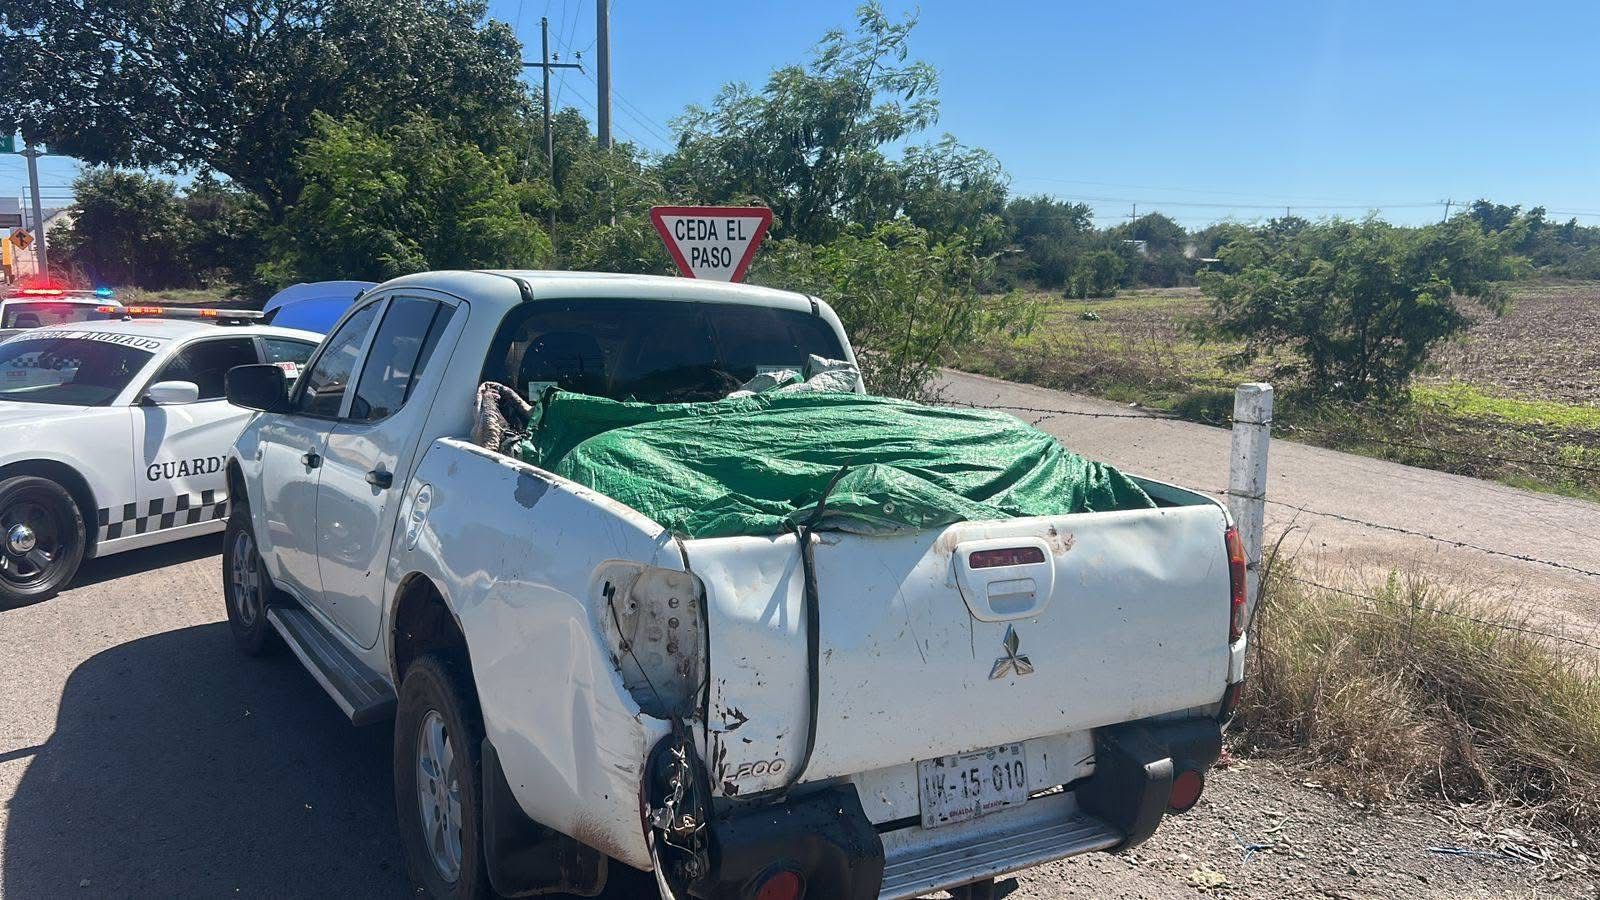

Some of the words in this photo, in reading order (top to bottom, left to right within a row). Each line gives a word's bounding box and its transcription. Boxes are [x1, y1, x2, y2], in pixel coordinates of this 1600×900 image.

[675, 219, 718, 241] CEDA
[727, 219, 747, 241] EL
[691, 246, 731, 268] PASO
